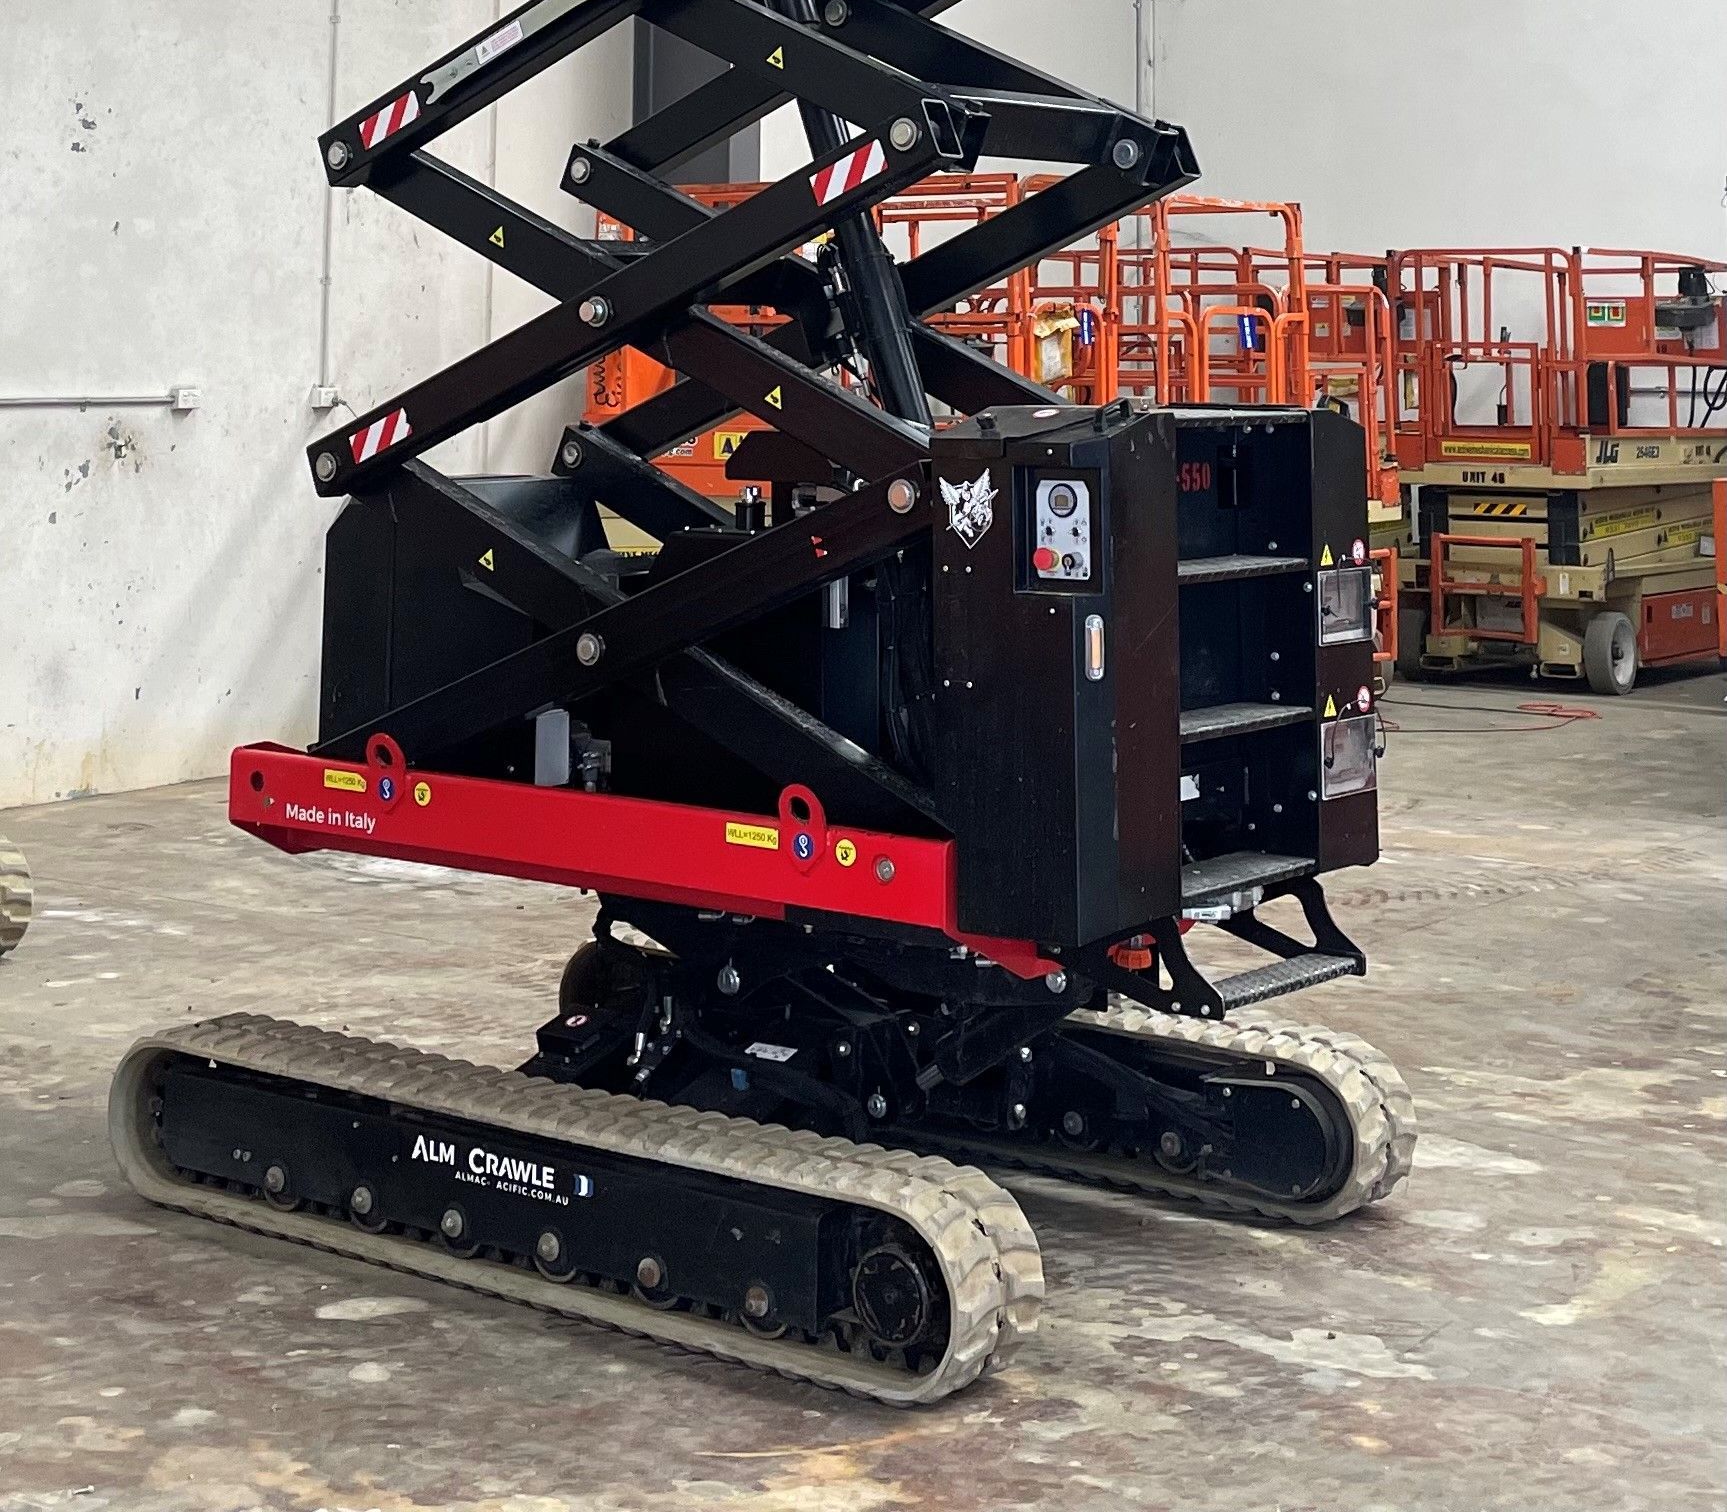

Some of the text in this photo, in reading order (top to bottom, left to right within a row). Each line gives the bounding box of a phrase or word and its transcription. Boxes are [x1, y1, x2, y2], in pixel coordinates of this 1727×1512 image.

[1596, 440, 1619, 464] JLG
[1462, 471, 1487, 484] UNIT
[285, 803, 376, 834] Made in Italy
[728, 828, 777, 846] WLL=1250 Kg
[411, 1134, 555, 1189] ALM CRAWLE
